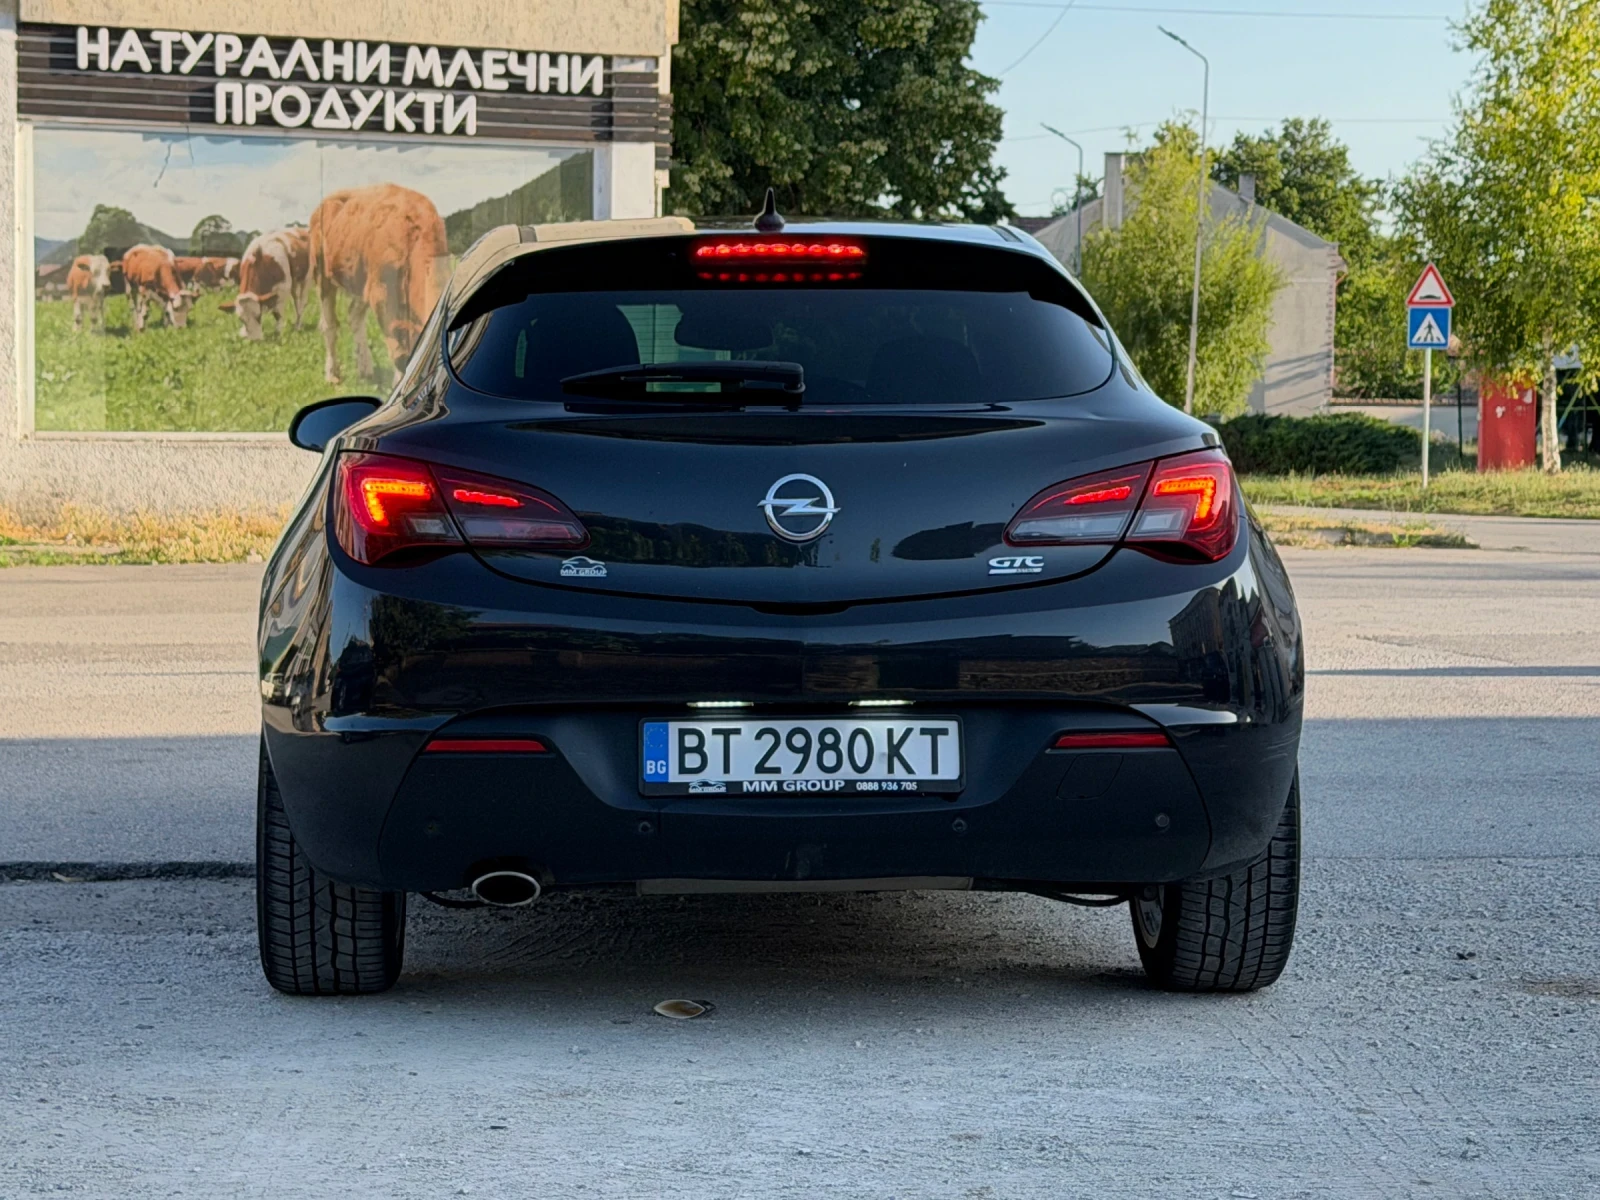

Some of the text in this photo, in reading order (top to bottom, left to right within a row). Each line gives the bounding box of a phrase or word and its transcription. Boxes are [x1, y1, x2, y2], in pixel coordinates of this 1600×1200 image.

[76, 27, 605, 95] НАТУРАЛНИ МЛЕЧНИ
[214, 83, 477, 135] ПРОДУКТИ
[988, 556, 1045, 568] GTC
[645, 759, 667, 775] BG
[678, 727, 950, 775] BT 2980 KT
[742, 780, 918, 793] MM GROUP 0888 936 705
